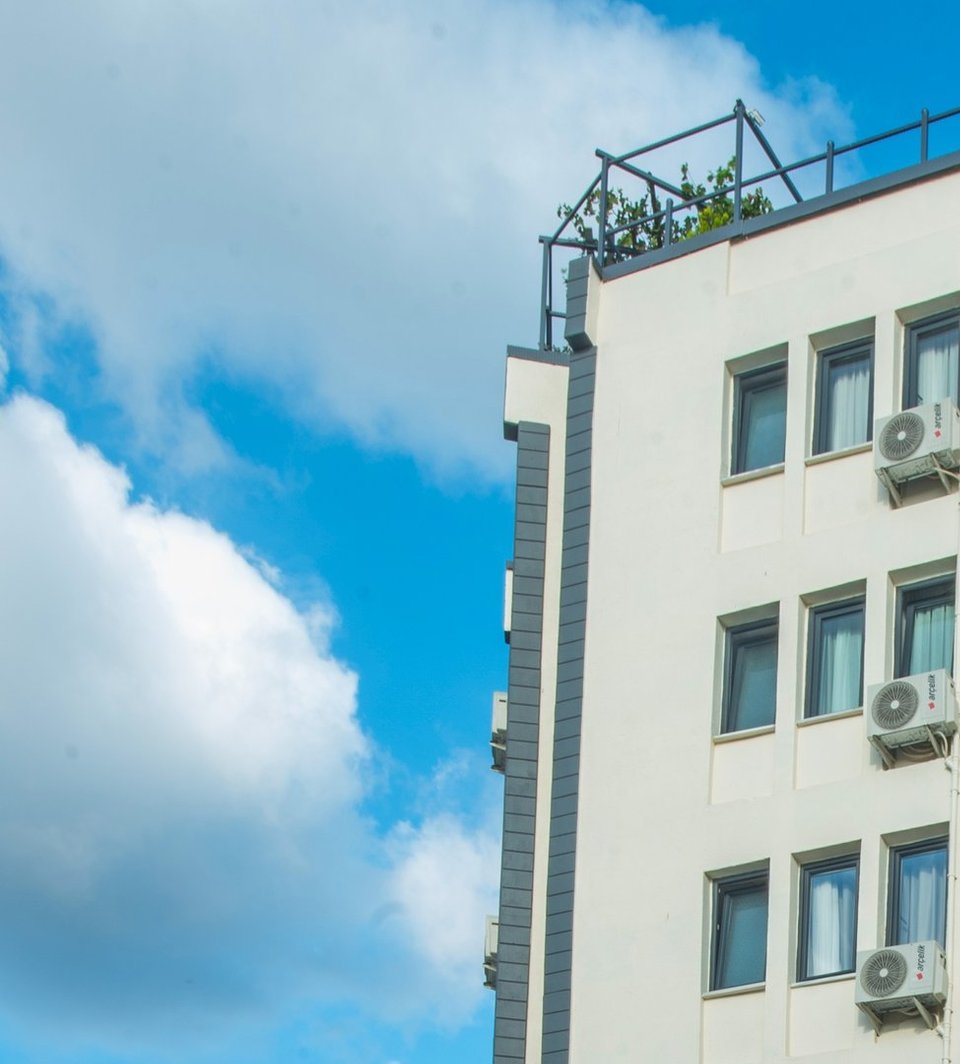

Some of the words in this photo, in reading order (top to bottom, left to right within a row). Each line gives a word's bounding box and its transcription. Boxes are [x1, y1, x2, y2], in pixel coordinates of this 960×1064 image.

[934, 403, 942, 429] arçelik
[928, 674, 936, 701] arçelik
[917, 944, 925, 971] arçelik
